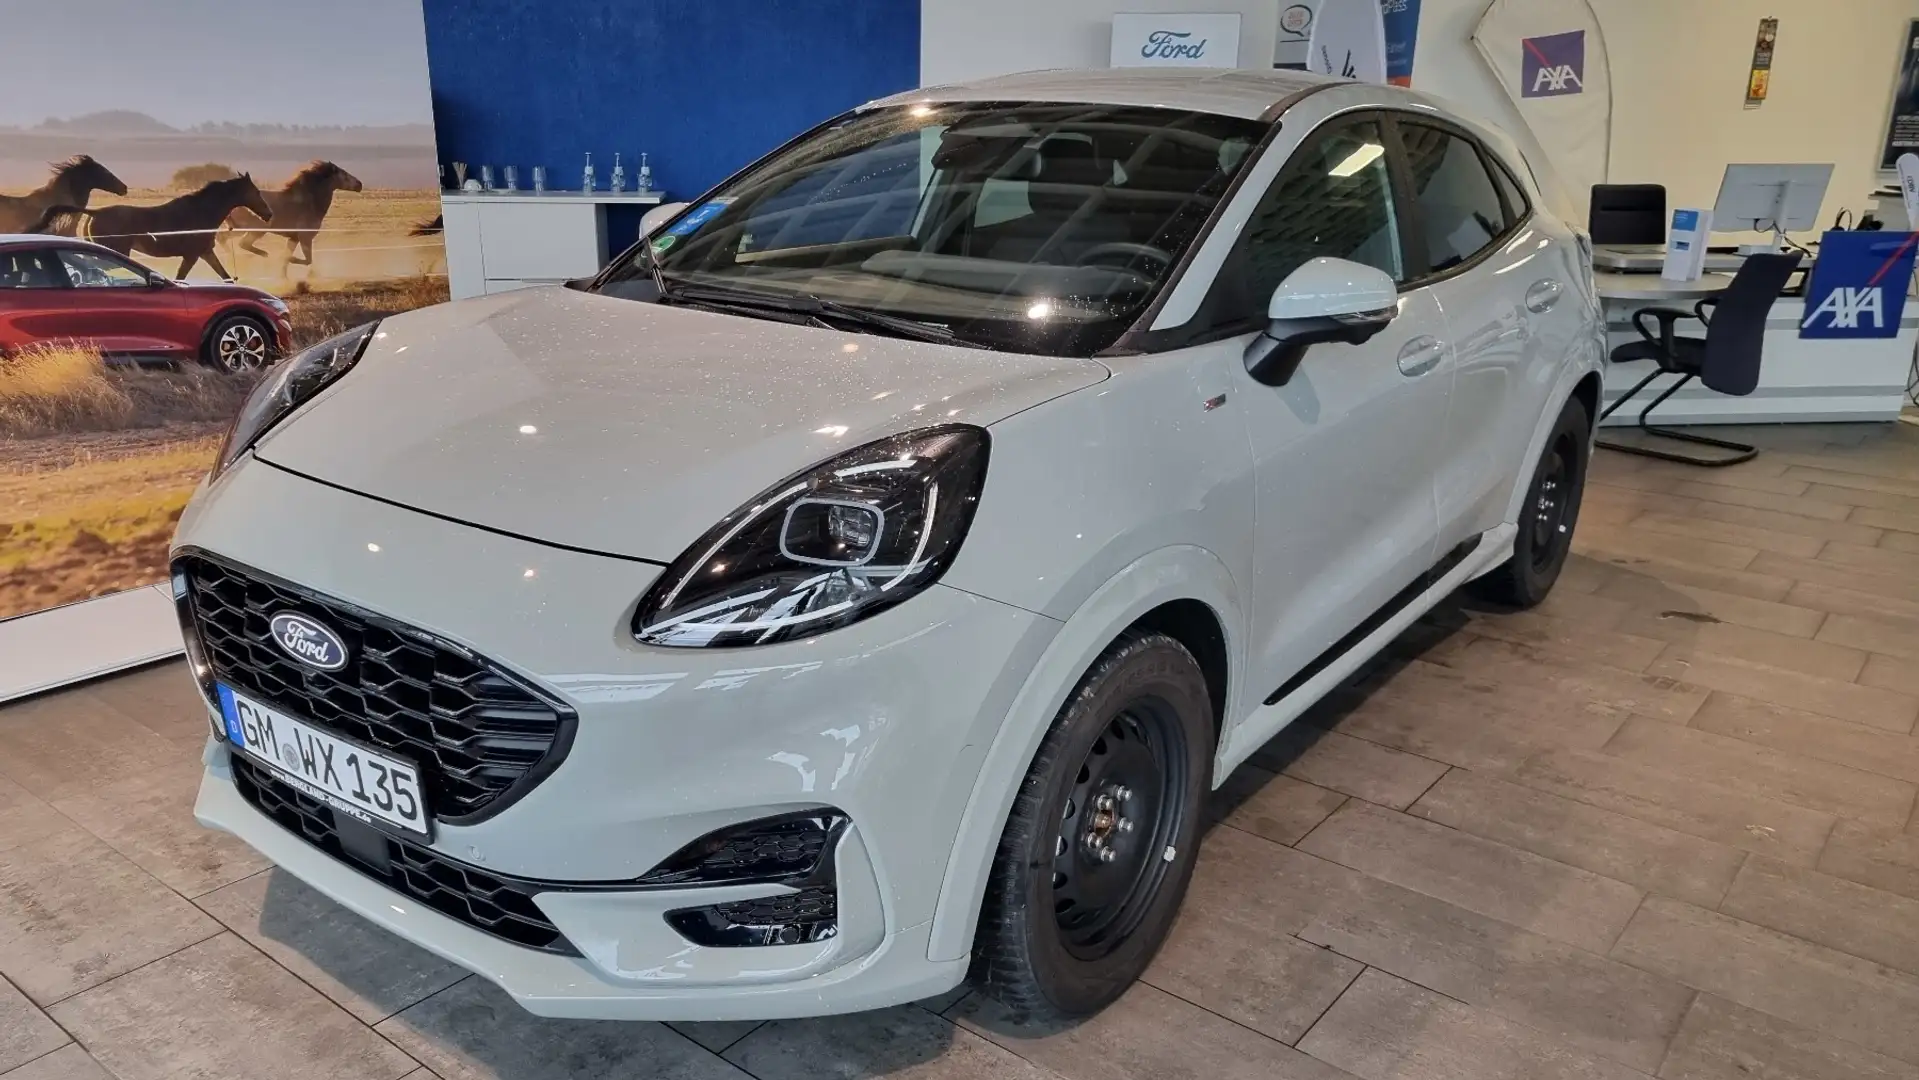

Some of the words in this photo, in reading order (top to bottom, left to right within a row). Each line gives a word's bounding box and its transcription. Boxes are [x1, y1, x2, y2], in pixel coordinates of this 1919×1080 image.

[1141, 30, 1207, 59] Ford
[1532, 64, 1582, 92] AXA
[1801, 287, 1884, 328] AXA
[284, 621, 329, 662] Ford
[236, 699, 280, 761] GM
[293, 727, 343, 791] WX
[346, 752, 418, 821] 135
